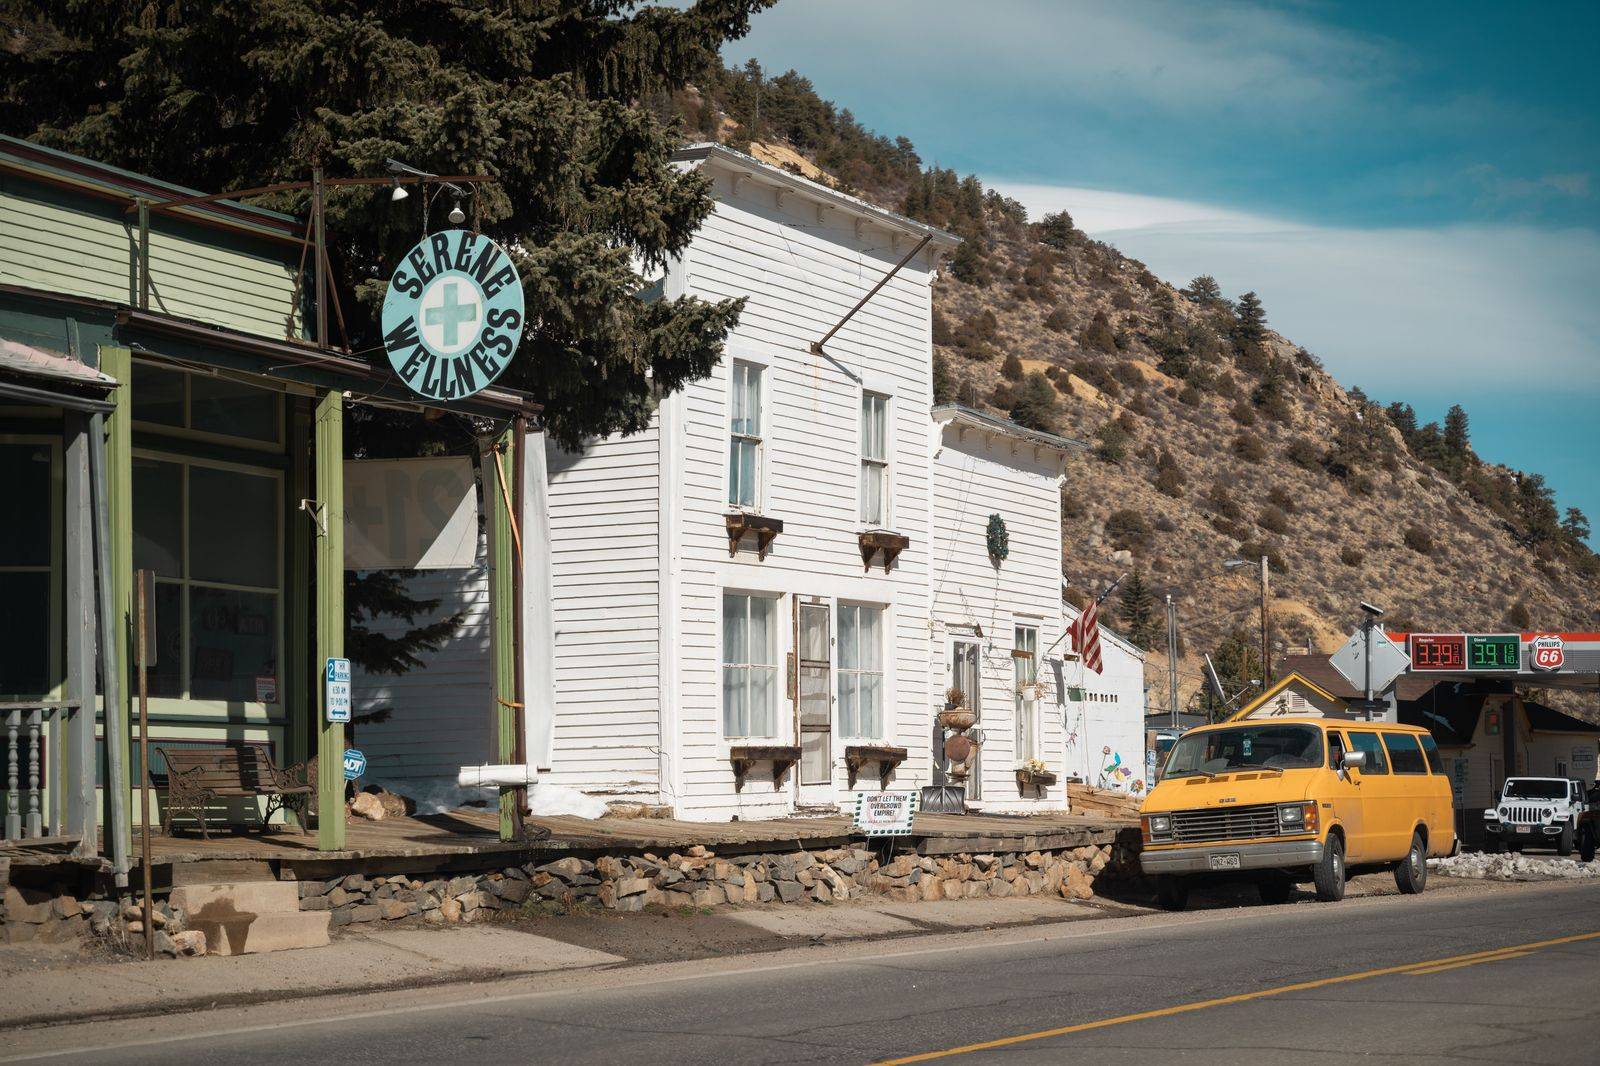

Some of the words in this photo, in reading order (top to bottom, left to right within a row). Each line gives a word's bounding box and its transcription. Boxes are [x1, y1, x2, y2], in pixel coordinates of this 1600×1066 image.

[392, 231, 517, 300] SERENE
[384, 307, 522, 399] WELLNESS
[1540, 650, 1560, 663] 66
[328, 662, 334, 679] 2
[344, 758, 363, 772] ADT
[870, 802, 902, 810] OVERCROWD
